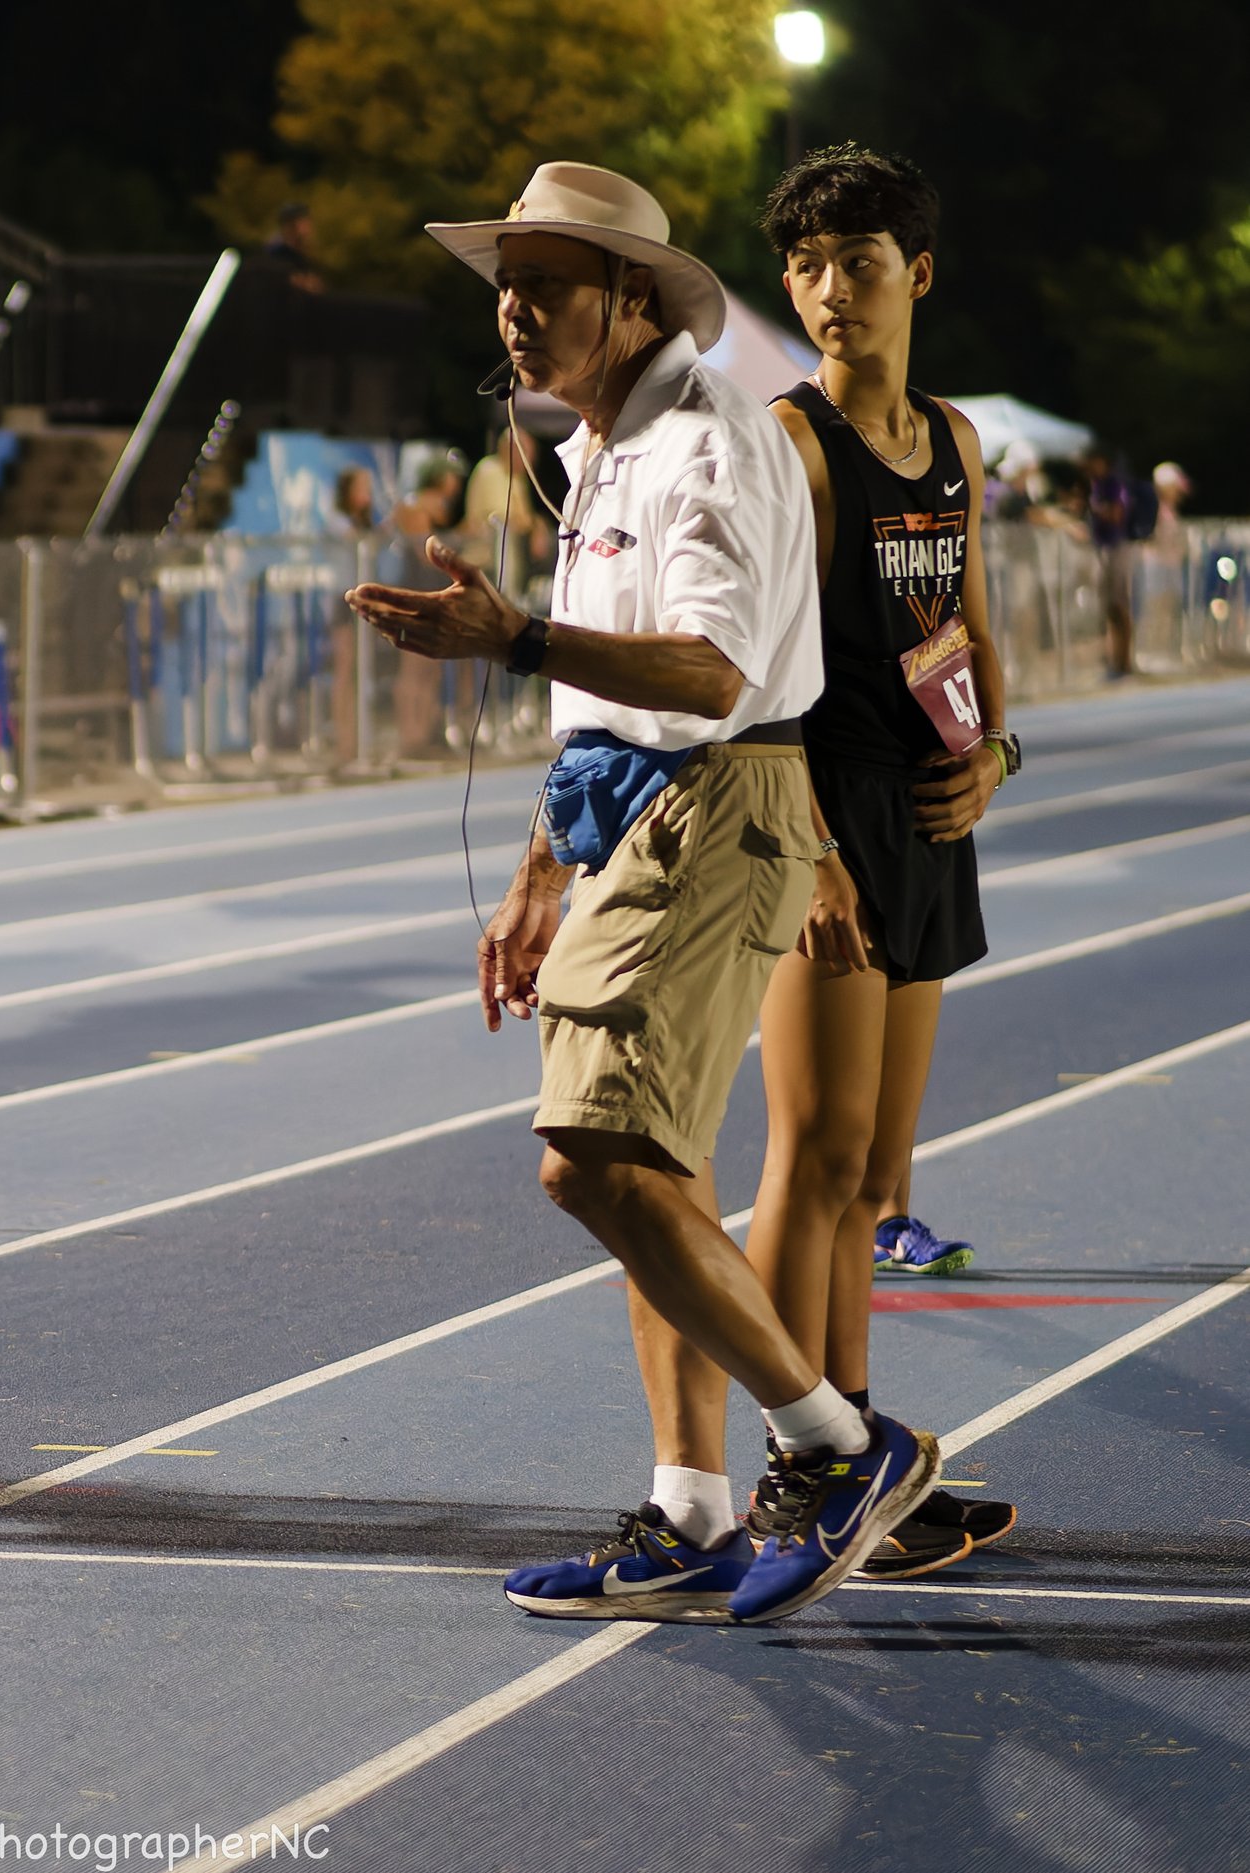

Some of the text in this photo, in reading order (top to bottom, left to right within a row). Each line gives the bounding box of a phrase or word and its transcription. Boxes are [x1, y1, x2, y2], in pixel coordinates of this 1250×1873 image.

[874, 535, 965, 579] TRIANGLE
[894, 576, 953, 597] ELITE
[942, 667, 981, 729] 47
